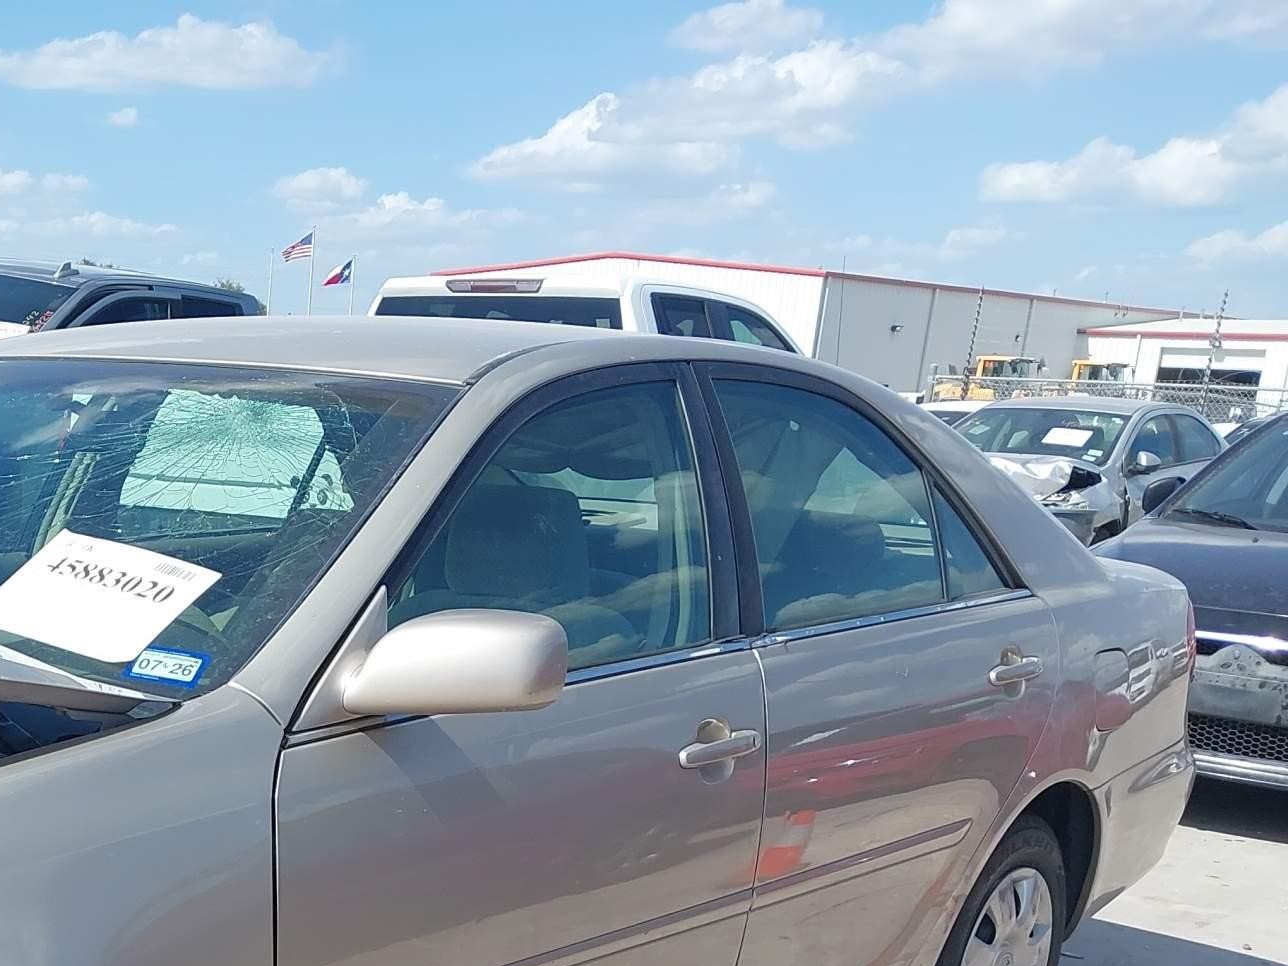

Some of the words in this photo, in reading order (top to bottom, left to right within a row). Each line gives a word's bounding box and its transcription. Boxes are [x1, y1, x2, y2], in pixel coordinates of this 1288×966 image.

[47, 556, 176, 604] 45883020
[138, 658, 163, 671] 07
[168, 663, 194, 677] 26
